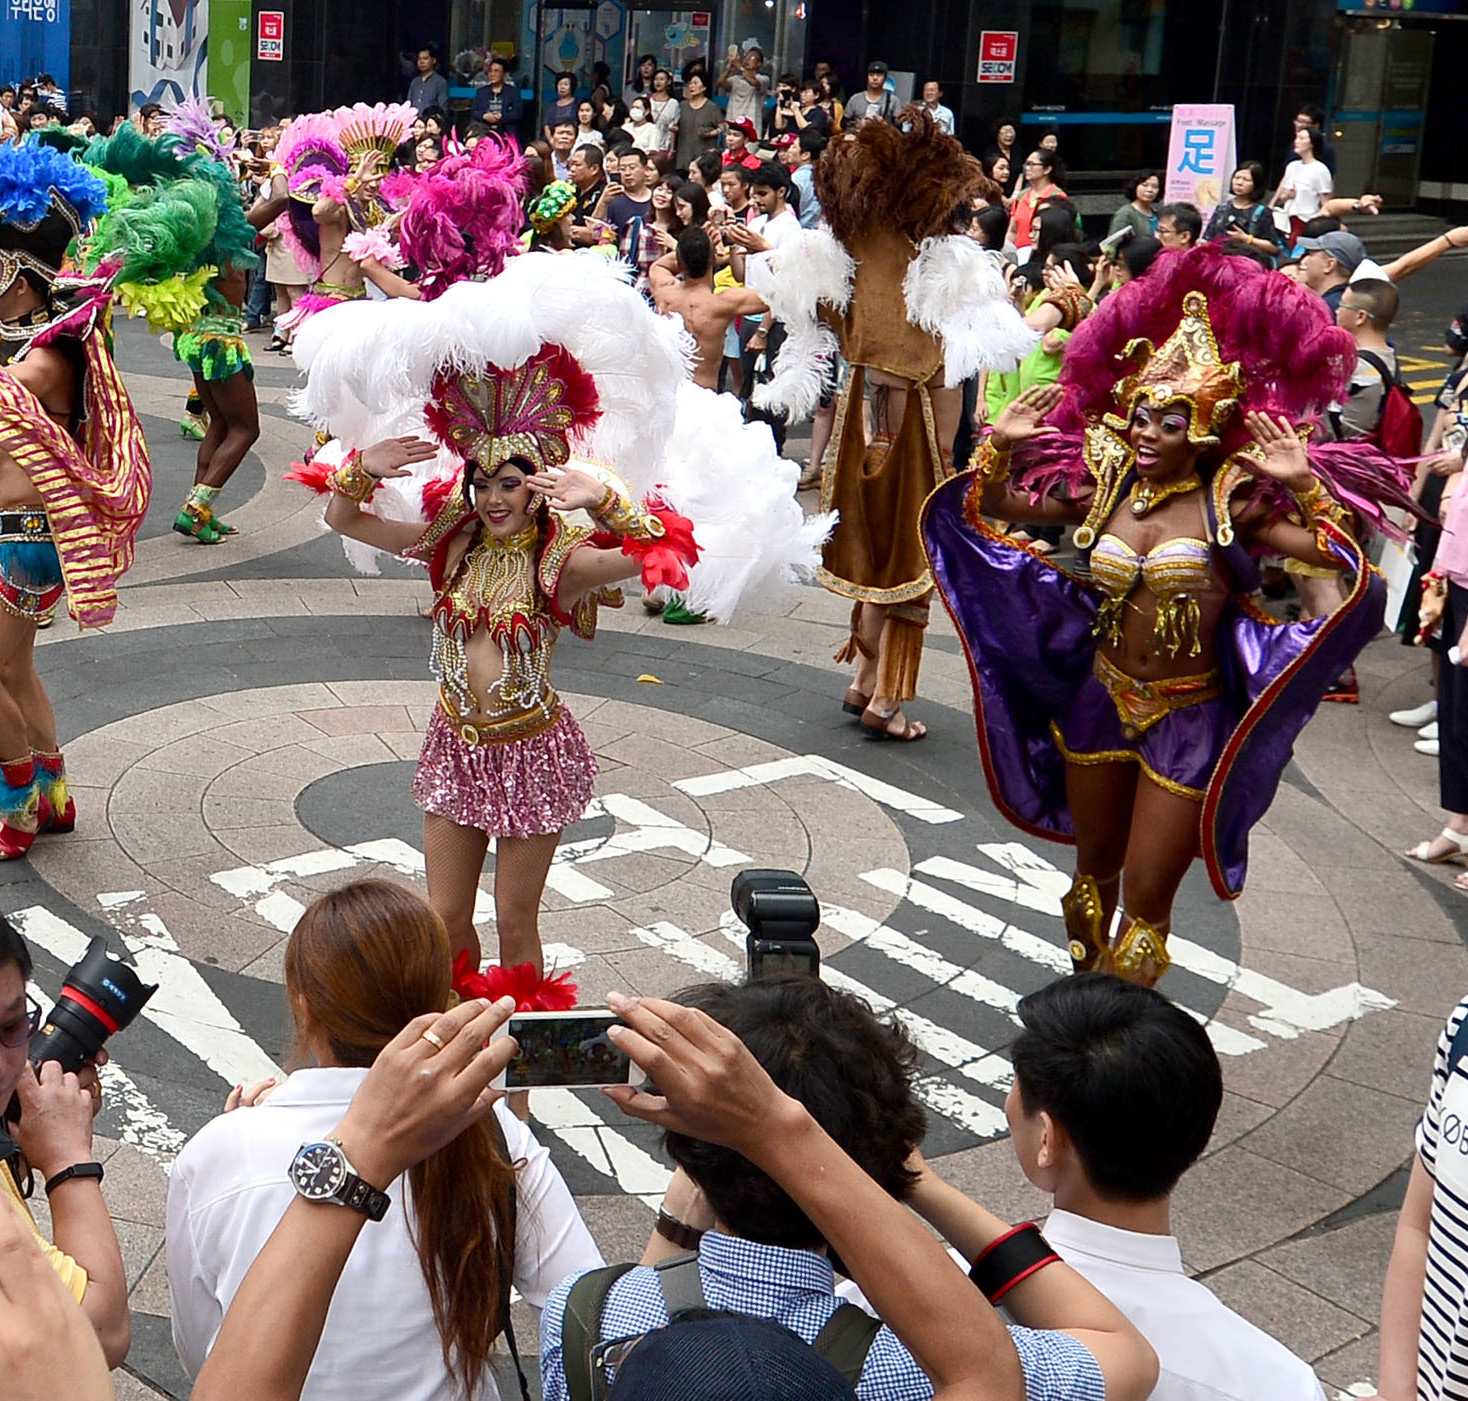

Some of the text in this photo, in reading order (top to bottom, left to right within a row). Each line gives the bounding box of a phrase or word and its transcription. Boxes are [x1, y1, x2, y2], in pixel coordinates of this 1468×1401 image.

[260, 40, 281, 51] SECOM
[981, 62, 1013, 74] SECOM
[1177, 119, 1227, 129] Foot Massage
[1176, 129, 1216, 175] 足
